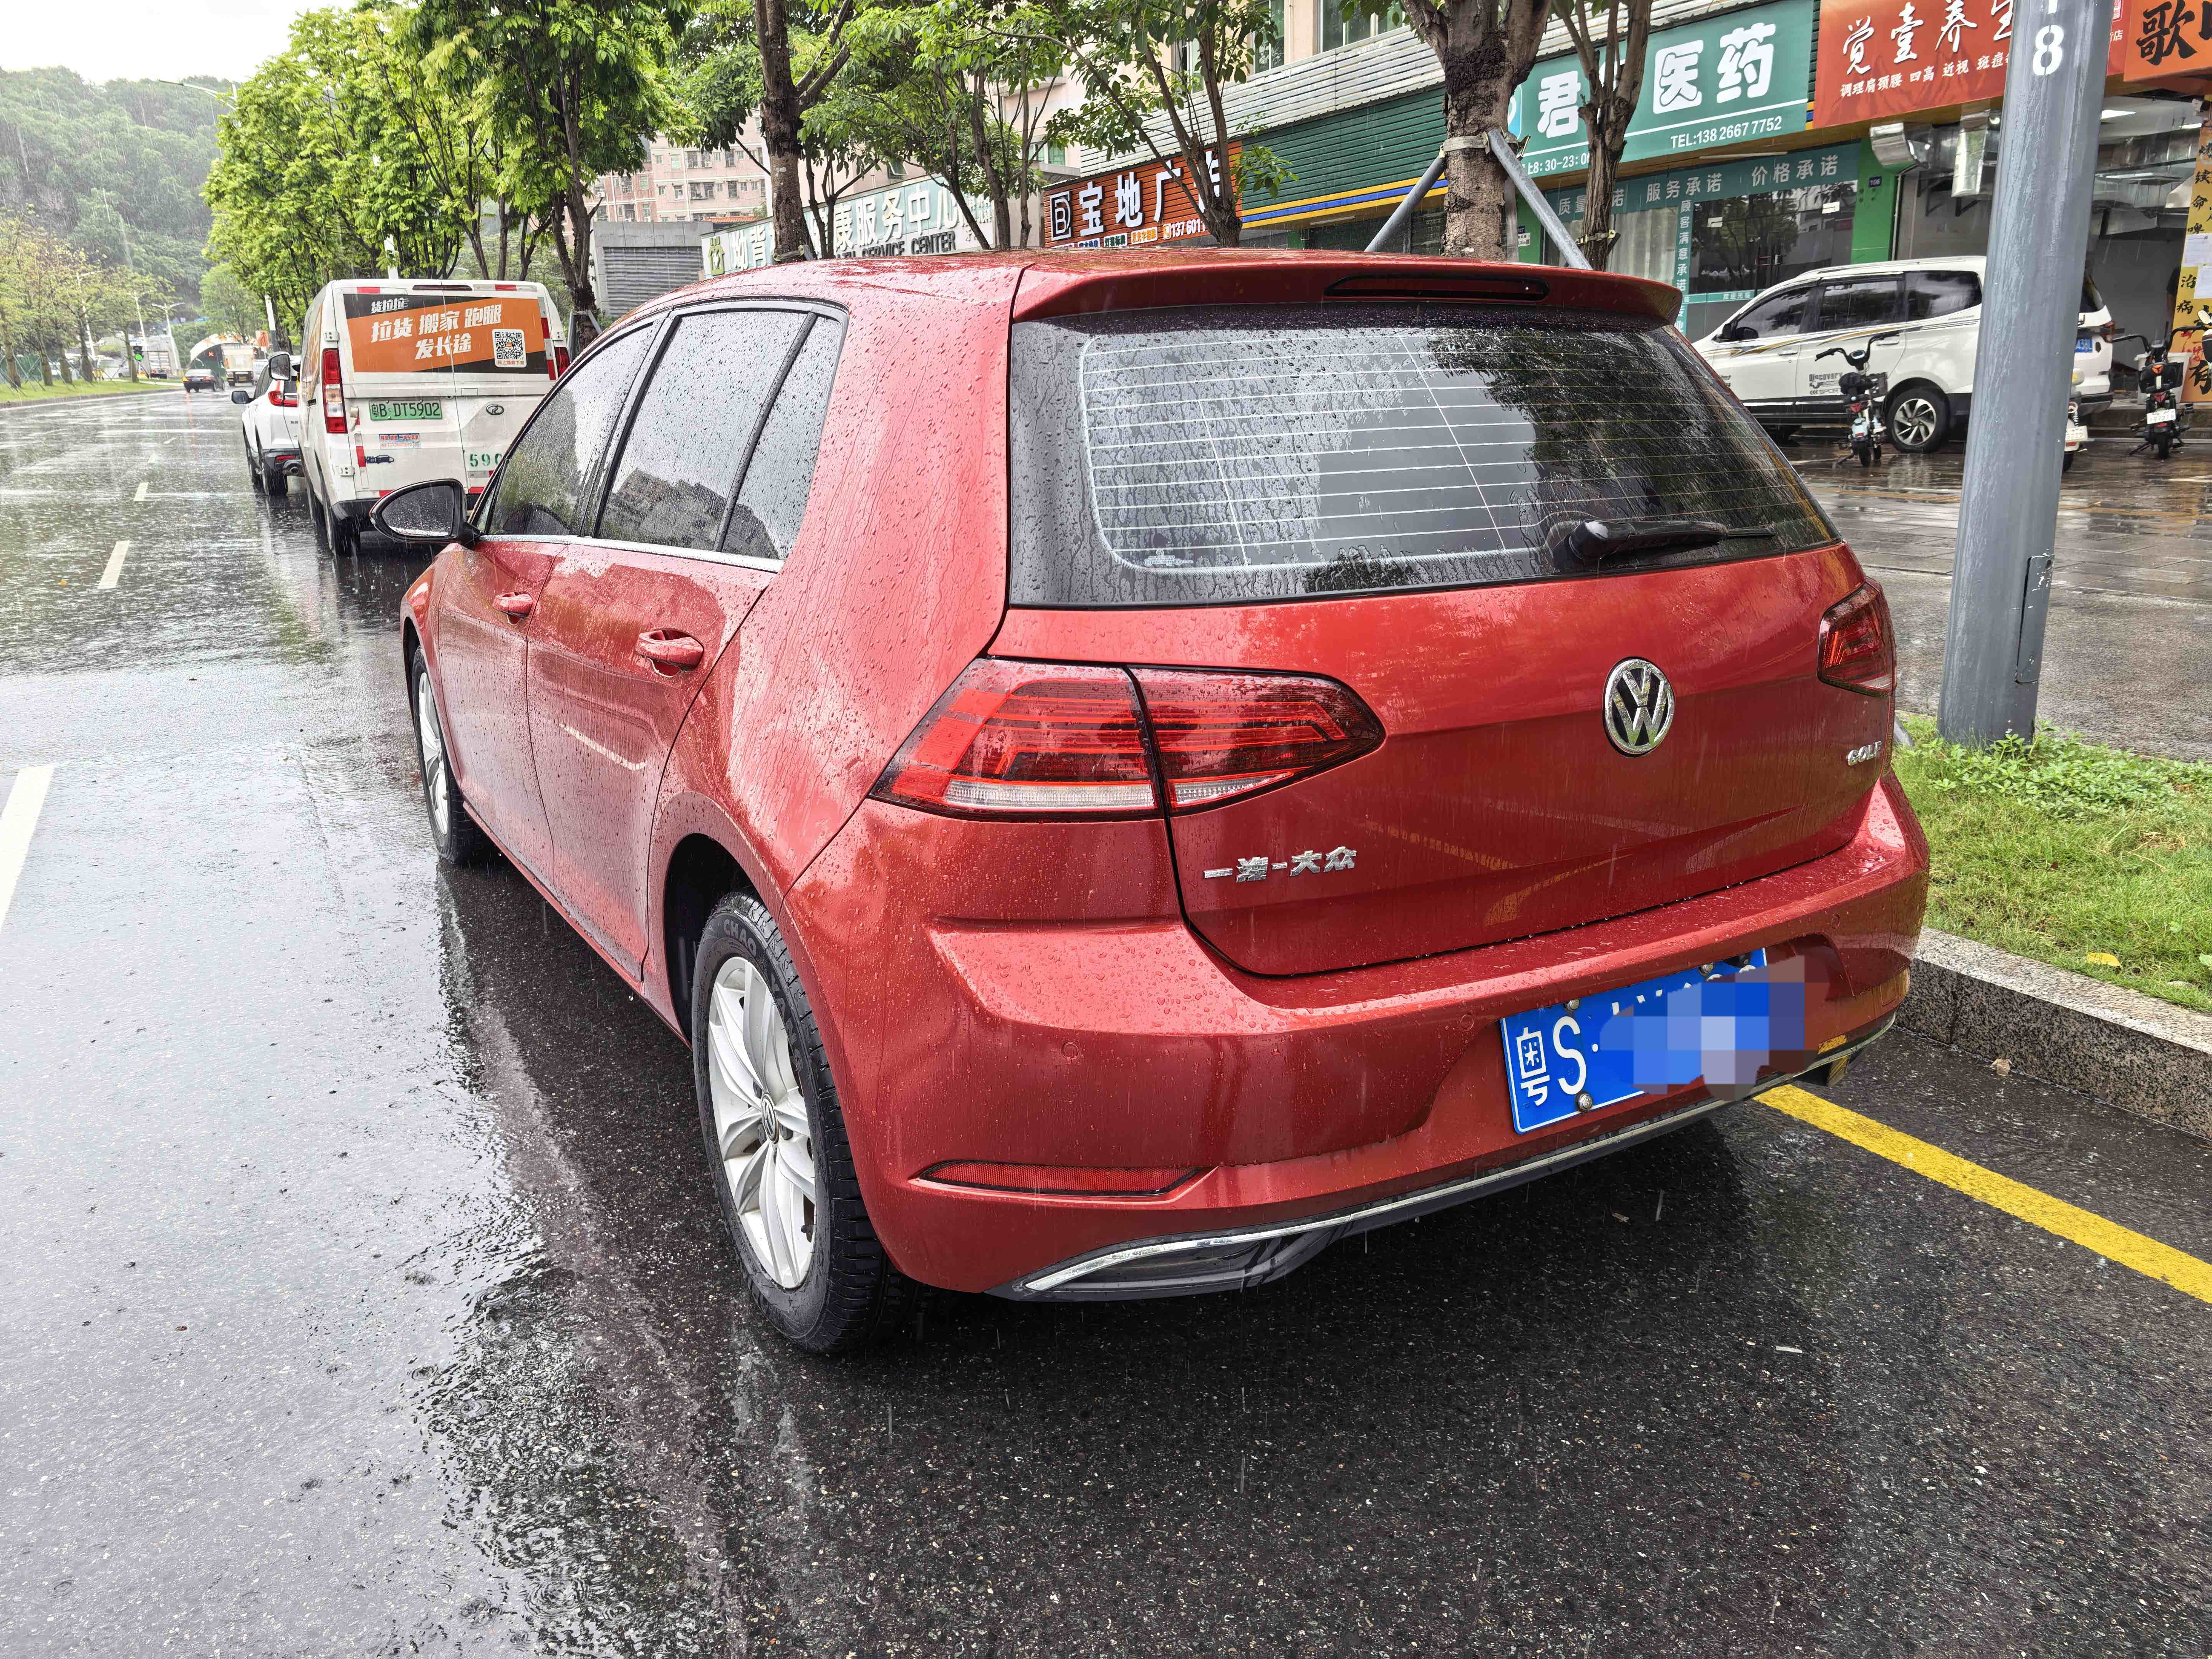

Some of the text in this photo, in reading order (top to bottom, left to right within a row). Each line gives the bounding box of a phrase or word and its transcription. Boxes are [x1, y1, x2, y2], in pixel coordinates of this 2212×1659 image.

[1537, 22, 1776, 138] 君医药
[1840, 52, 2009, 98] 调理肩颈腰 四高 近视 斑痘
[1671, 116, 1782, 149] TEL:138 2667 7752
[1646, 172, 1722, 203] 服务承诺
[1751, 155, 1839, 187] 价格承诺
[911, 231, 956, 255] CENTER
[1171, 222, 1185, 238] 137
[371, 297, 410, 314] 货拉拉
[371, 304, 502, 343] 拉货 搬家 跑腿
[414, 333, 472, 360] 发长途
[1846, 740, 1882, 766] GOLF
[723, 919, 757, 956] CHAO
